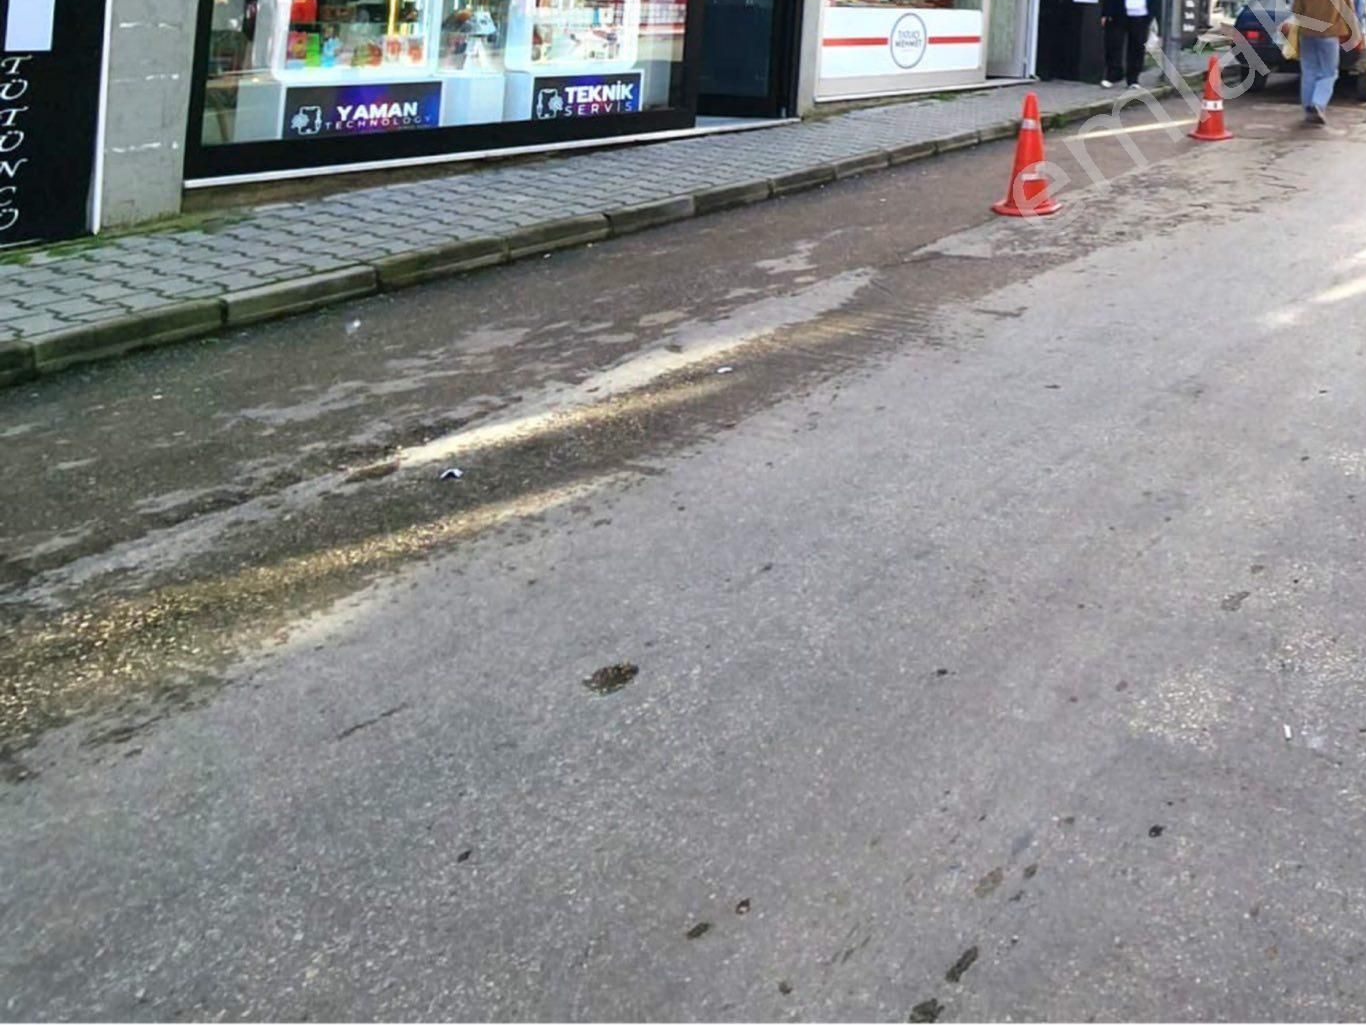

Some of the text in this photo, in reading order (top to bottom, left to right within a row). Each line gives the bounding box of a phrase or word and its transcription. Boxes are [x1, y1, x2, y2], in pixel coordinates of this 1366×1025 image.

[564, 80, 634, 103] TEKNİK
[336, 101, 418, 122] YAMAN
[325, 115, 431, 131] TECHNOLOGY
